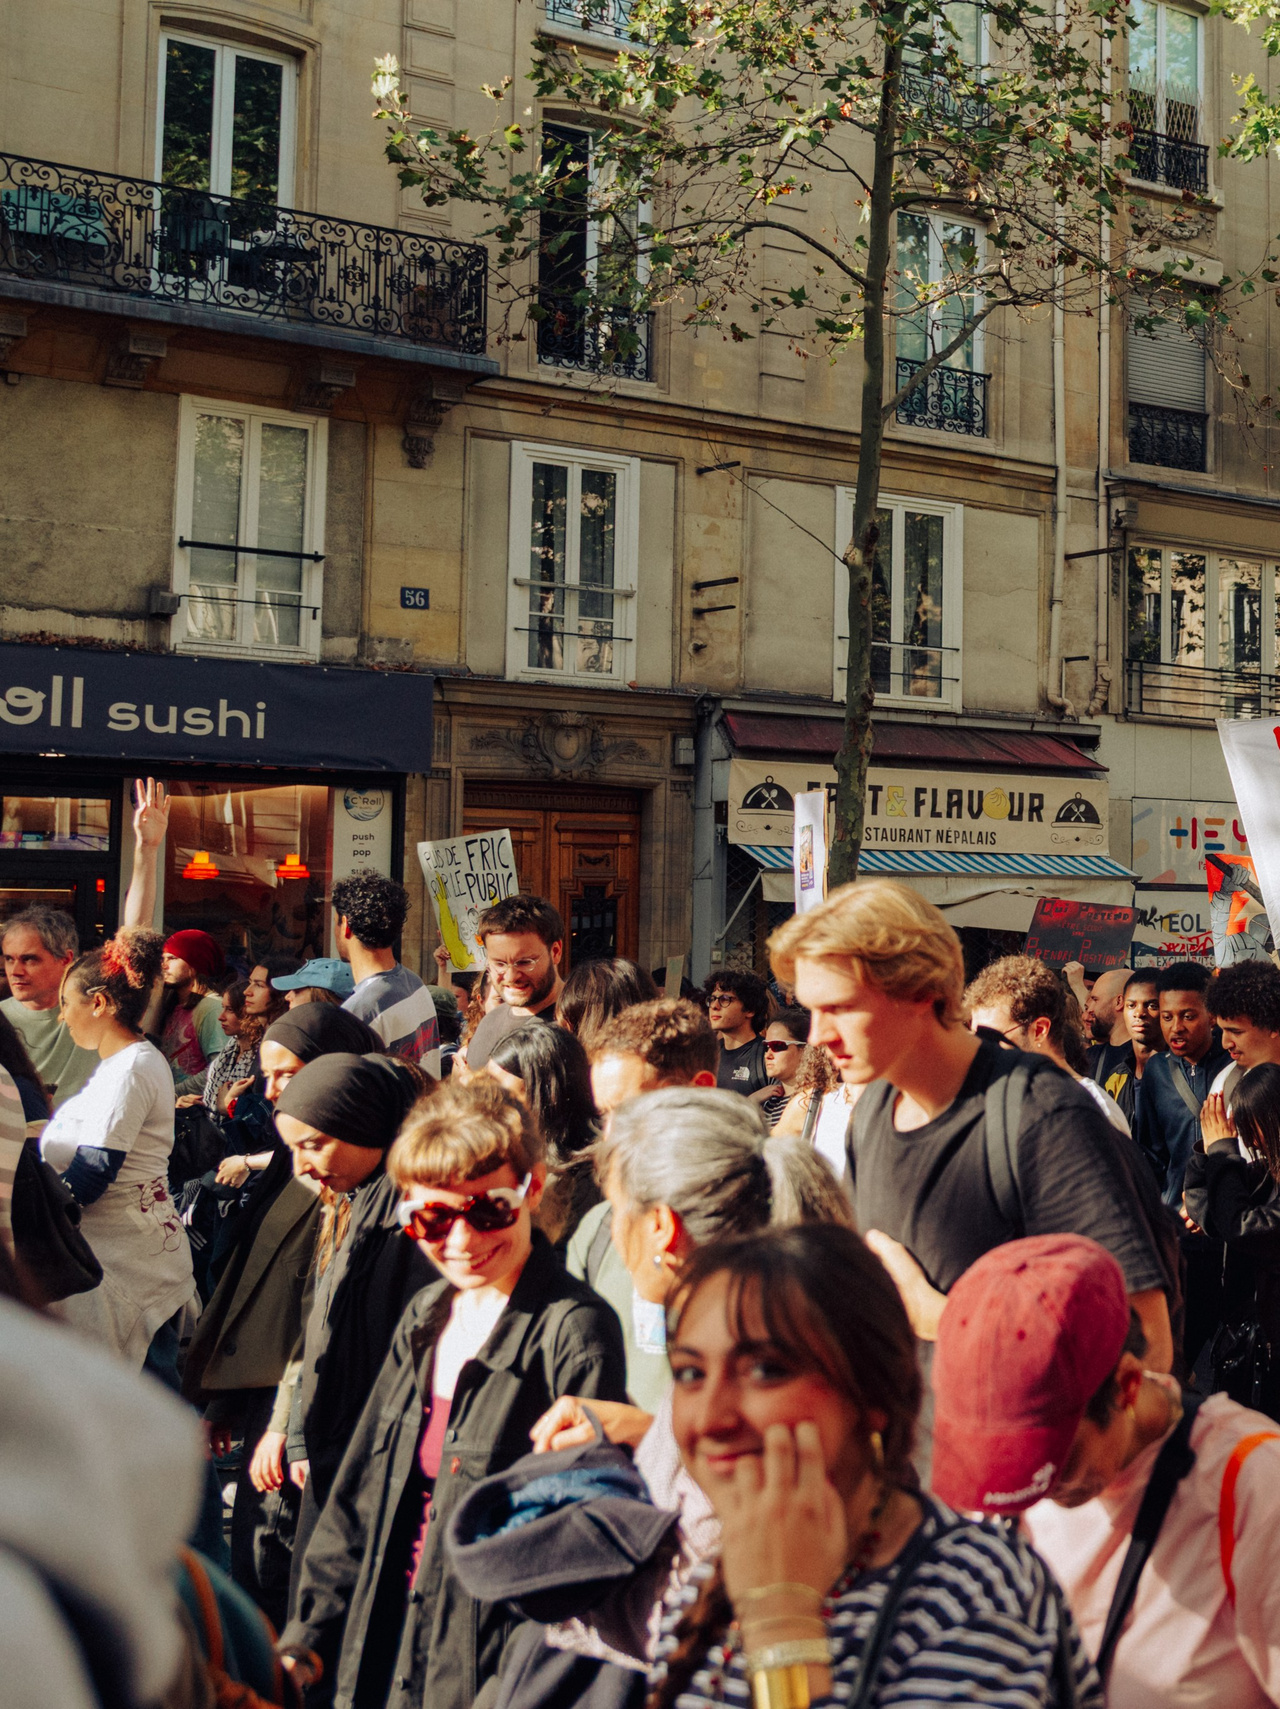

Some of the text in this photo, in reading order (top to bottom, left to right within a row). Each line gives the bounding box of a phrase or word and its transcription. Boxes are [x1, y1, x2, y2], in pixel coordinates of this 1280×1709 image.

[405, 590, 425, 607] 56
[107, 699, 267, 739] sushi
[352, 833, 375, 841] push
[936, 827, 997, 845] NÉPALAIS
[352, 849, 371, 857] pop
[444, 846, 461, 866] DE
[465, 837, 510, 871] FRIC
[450, 870, 466, 898] LE
[465, 872, 513, 903] PUBLIC
[1040, 901, 1069, 917] Qui
